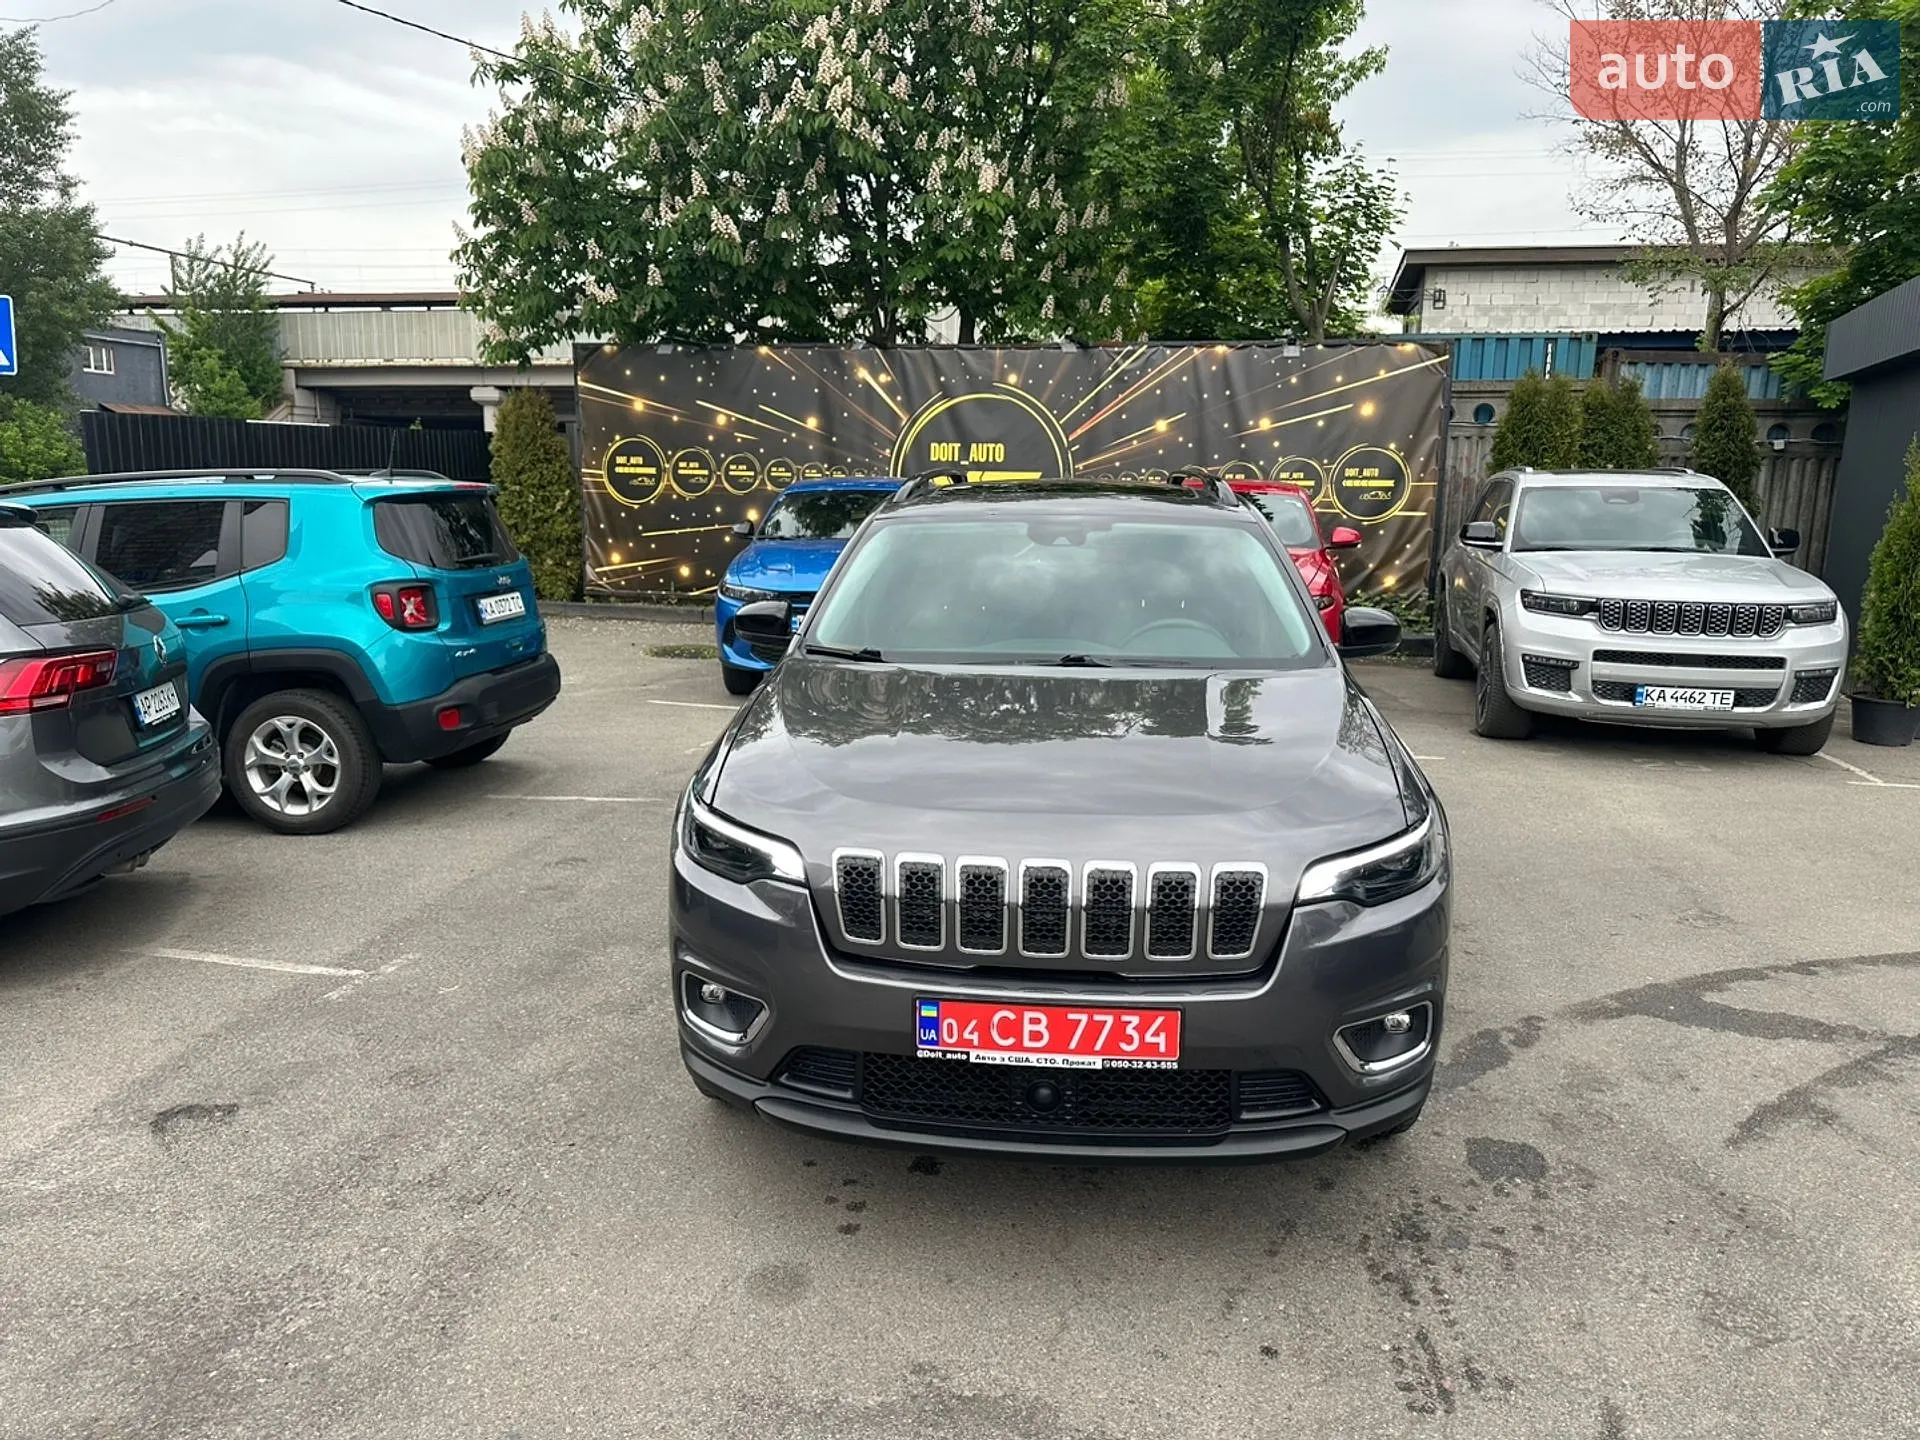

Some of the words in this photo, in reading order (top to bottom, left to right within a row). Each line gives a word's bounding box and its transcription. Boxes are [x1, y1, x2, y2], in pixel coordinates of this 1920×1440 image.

[930, 442, 1005, 465] DOIT_AUTO
[1645, 688, 1667, 702] KA
[1670, 690, 1707, 704] 4462
[1710, 692, 1732, 705] TE
[920, 1028, 937, 1041] UA
[942, 1018, 979, 1046] 04
[989, 1010, 1050, 1048] CB
[1067, 1013, 1166, 1053] 7734
[1062, 1058, 1096, 1068] Прокат
